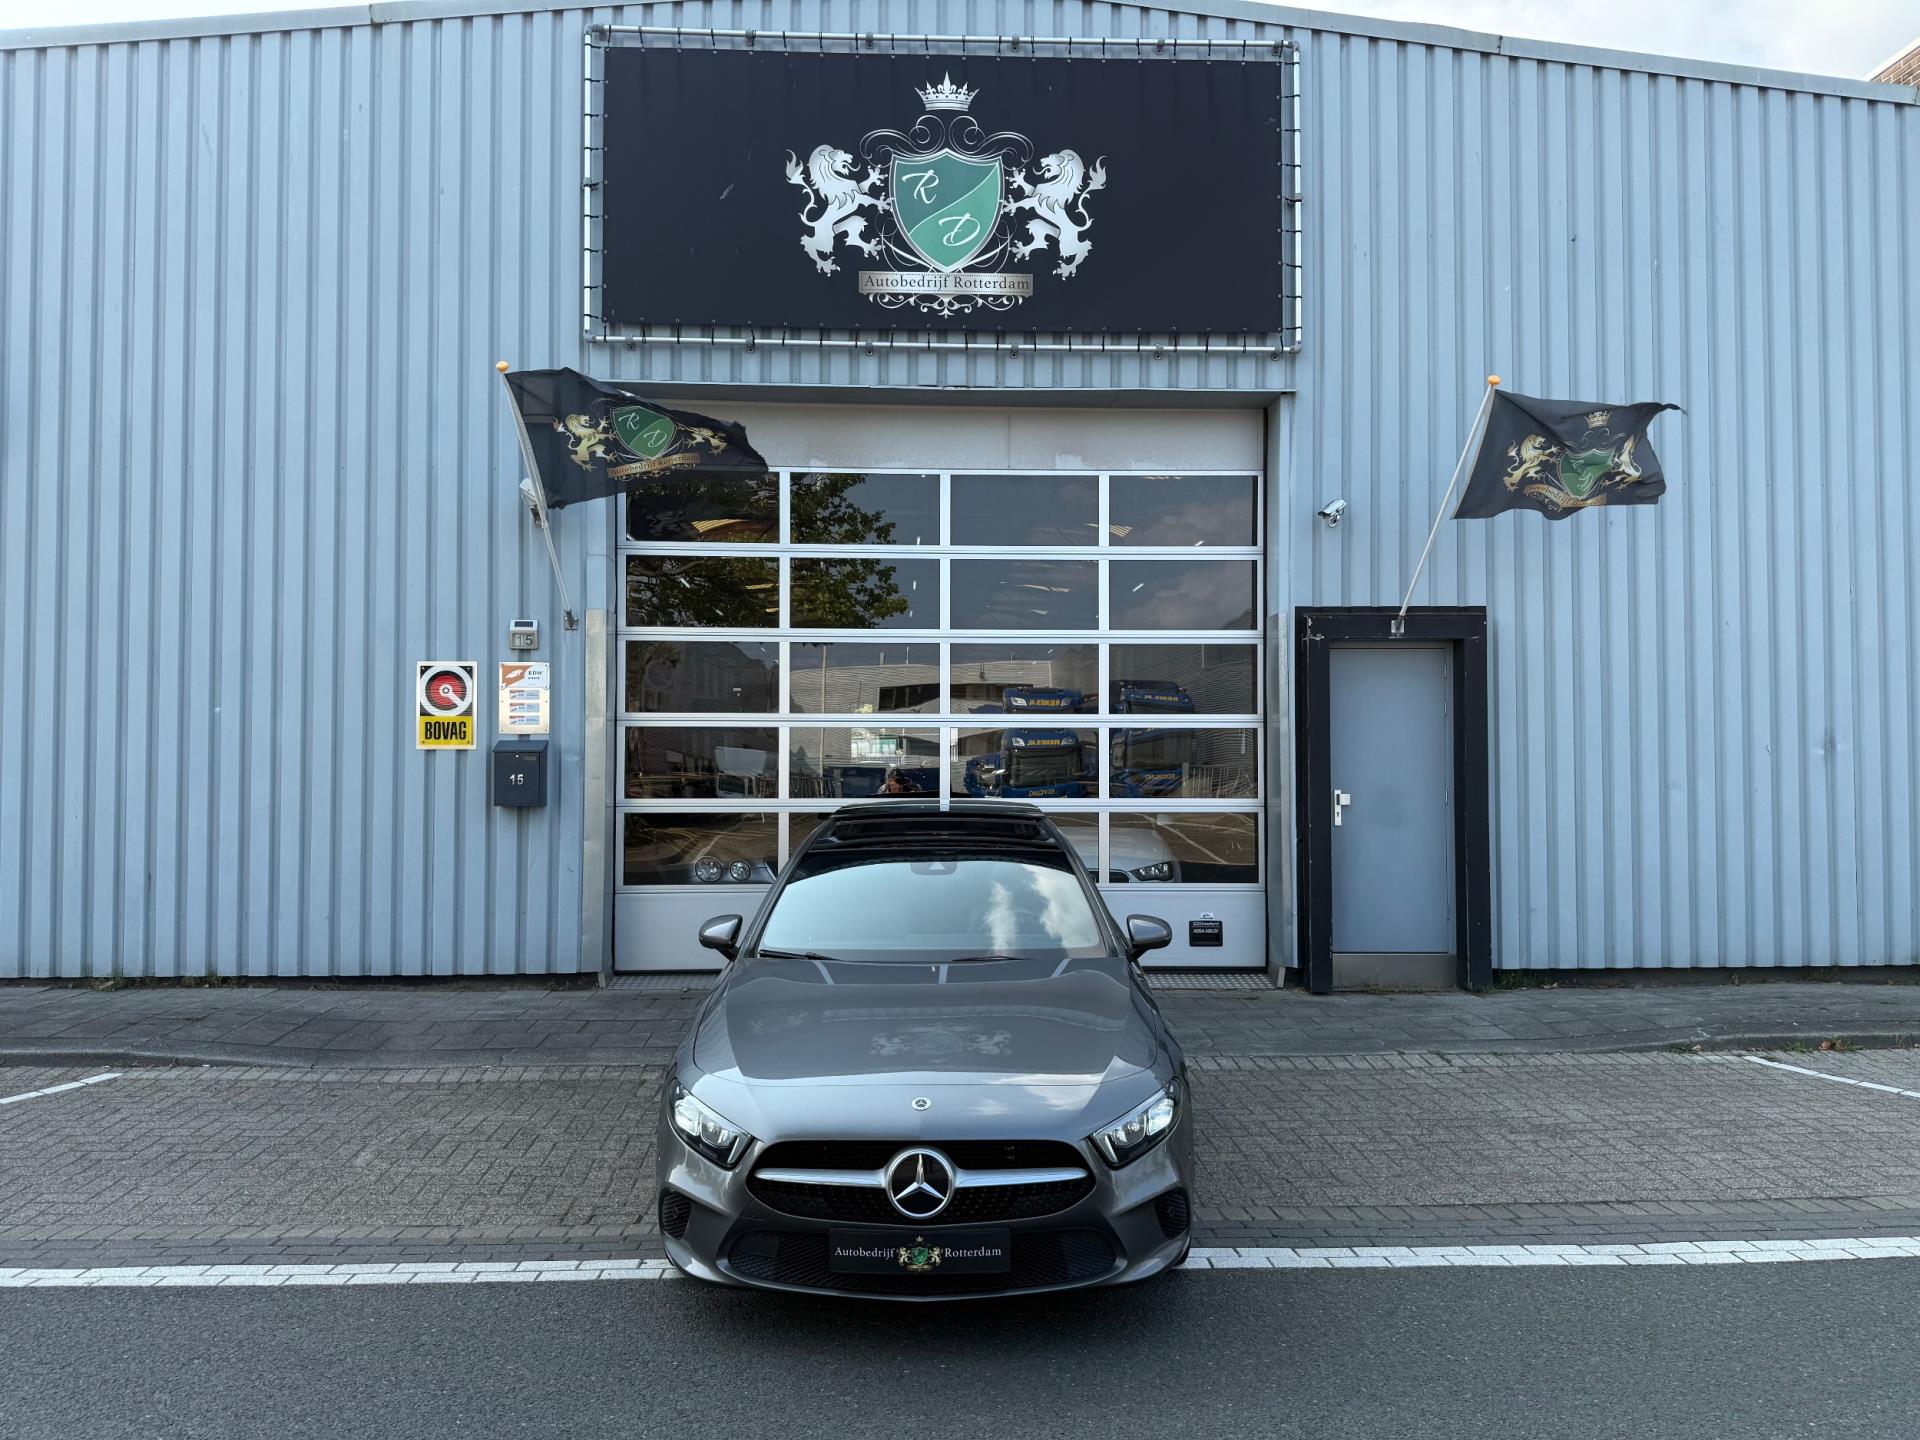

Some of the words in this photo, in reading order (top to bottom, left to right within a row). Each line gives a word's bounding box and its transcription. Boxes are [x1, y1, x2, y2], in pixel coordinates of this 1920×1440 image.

[902, 169, 940, 204] R
[938, 212, 980, 247] D
[863, 274, 950, 291] Autobedrijf
[953, 275, 1031, 290] Rotterdam
[517, 634, 533, 646] 15
[424, 721, 467, 740] BOVAG
[510, 773, 524, 785] 15
[834, 1246, 896, 1260] Autobedrijf
[944, 1246, 1002, 1257] Rotterdam
